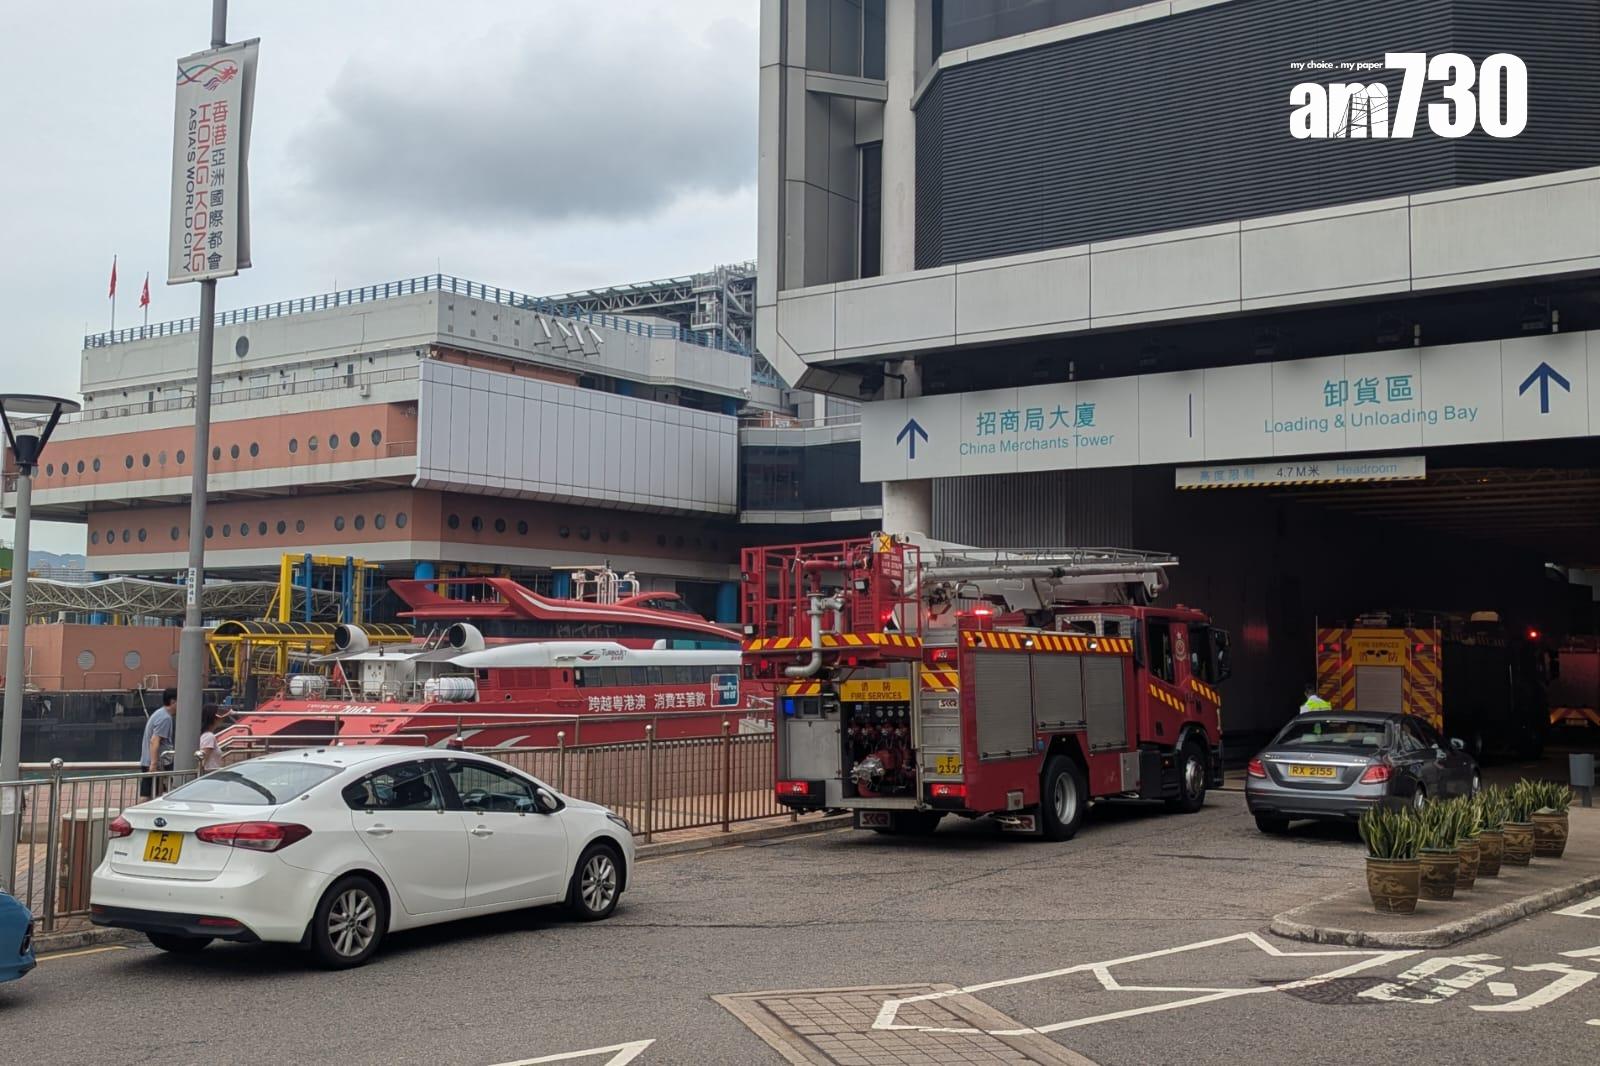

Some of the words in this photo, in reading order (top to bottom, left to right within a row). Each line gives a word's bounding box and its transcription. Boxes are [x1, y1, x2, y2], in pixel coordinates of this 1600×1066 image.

[186, 108, 197, 162] ASIA'S
[196, 104, 211, 184] HONG
[184, 166, 195, 229] WORLD
[192, 191, 208, 272] KONG
[183, 232, 192, 272] CITY
[1324, 375, 1413, 407] 卸貨區
[976, 402, 1096, 436] 招商局大廈
[1264, 416, 1328, 433] Loading
[1335, 414, 1345, 428] &
[1351, 408, 1437, 427] Unloading
[1444, 405, 1478, 422] Bay
[960, 441, 996, 456] China
[1000, 436, 1069, 453] Merchants
[1073, 434, 1115, 448] Tower
[1336, 463, 1397, 475] Headroom
[851, 691, 866, 699] FIRE
[868, 691, 902, 699] SERVICES
[1292, 766, 1307, 774] RX
[1310, 767, 1333, 776] 2155
[149, 846, 174, 861] 1221
[159, 831, 169, 846] F
